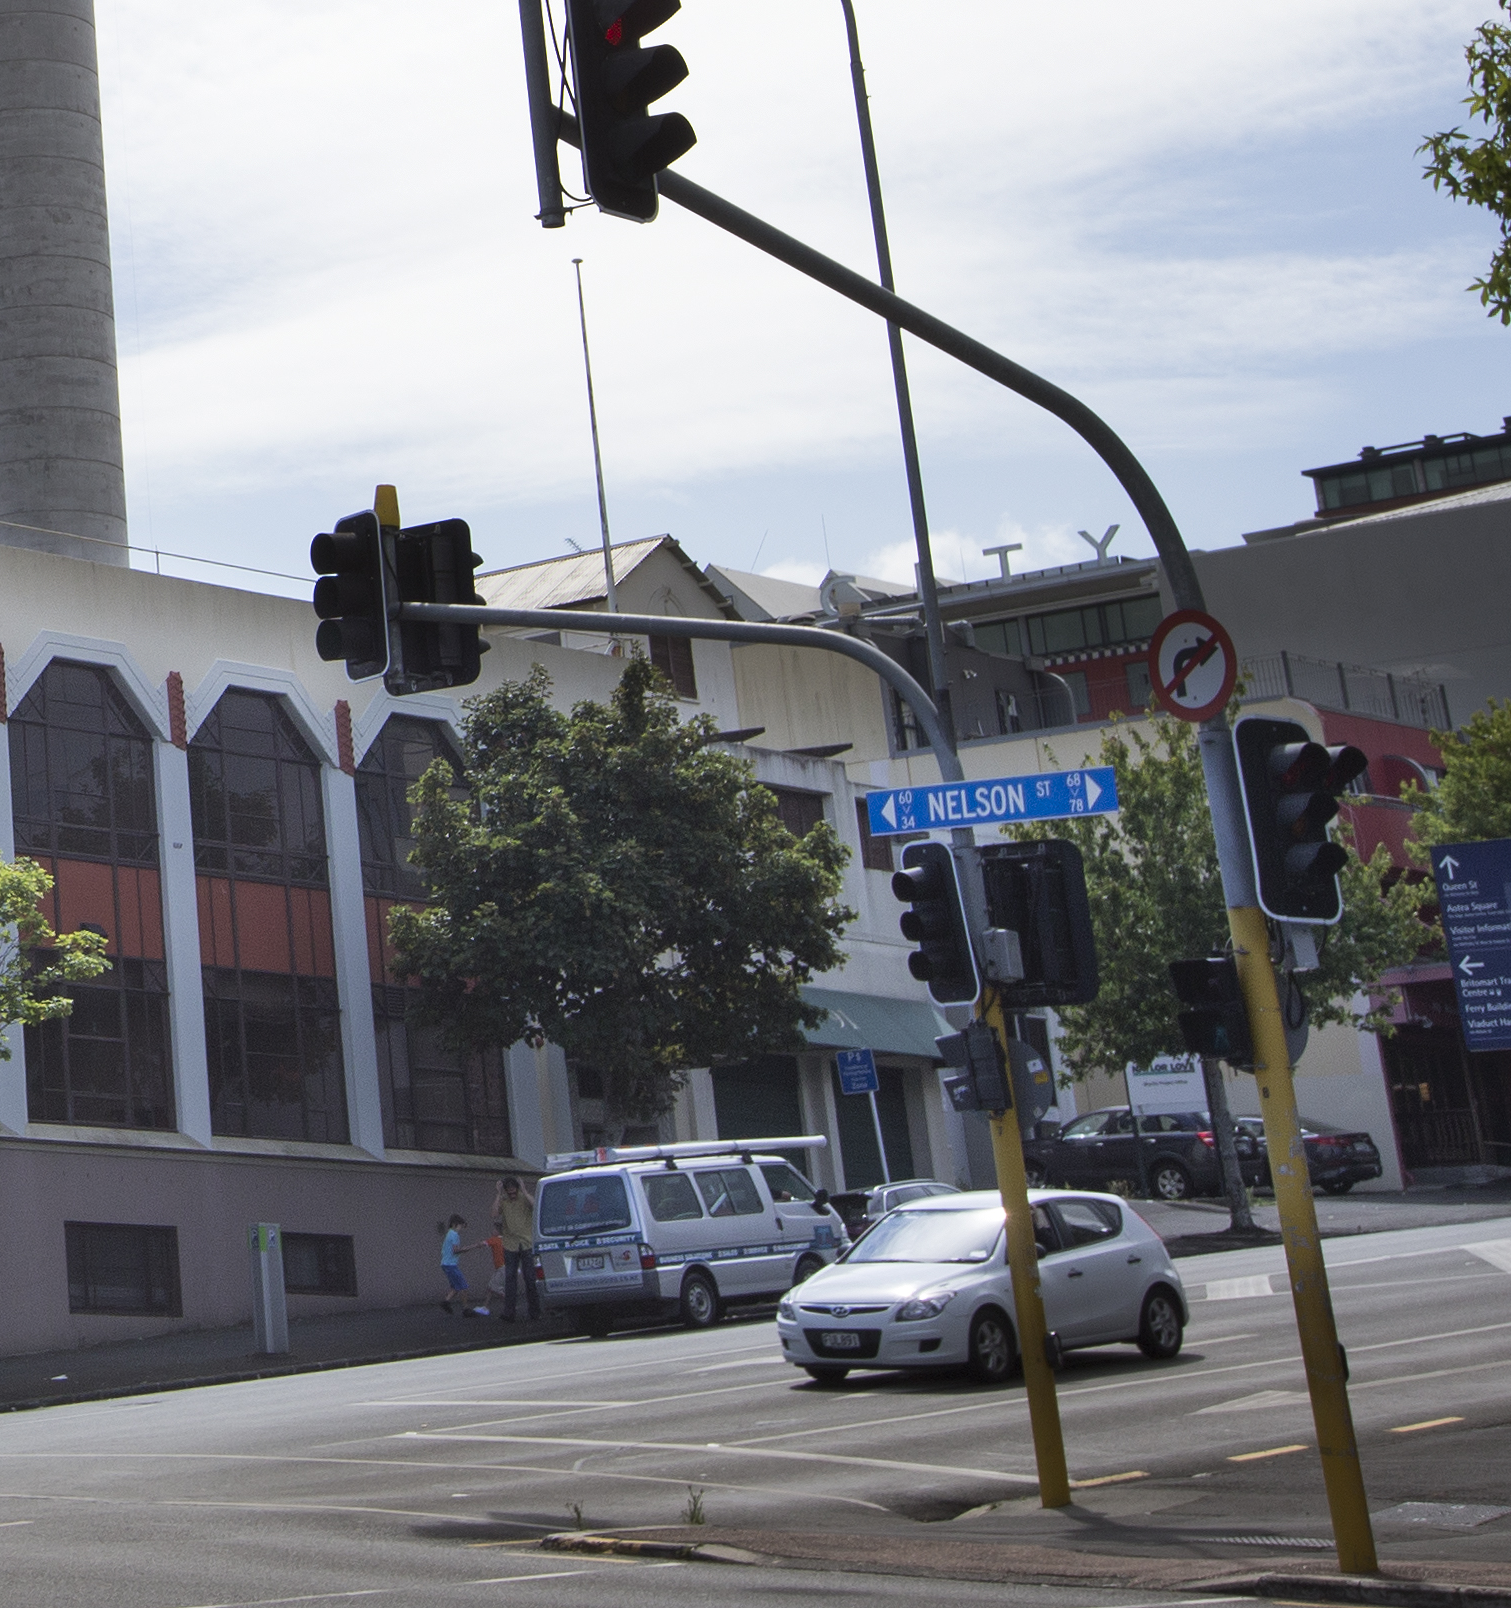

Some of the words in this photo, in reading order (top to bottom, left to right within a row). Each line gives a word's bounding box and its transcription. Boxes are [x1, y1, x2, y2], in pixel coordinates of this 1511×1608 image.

[1066, 773, 1081, 788] 68
[898, 791, 913, 804] 60
[927, 783, 1026, 822] NELSON
[1036, 781, 1051, 798] ST
[1068, 799, 1084, 813] 78
[901, 815, 915, 829] 34
[1442, 883, 1467, 891] Queen
[1468, 880, 1478, 889] St
[1446, 904, 1470, 912] Aotea
[1470, 902, 1498, 912] Square
[1449, 926, 1476, 935] Visitor
[1460, 978, 1498, 988] Britomart
[1462, 989, 1488, 997] Centre
[1465, 1004, 1485, 1013] Ferry
[1467, 1019, 1498, 1029] Viaduct
